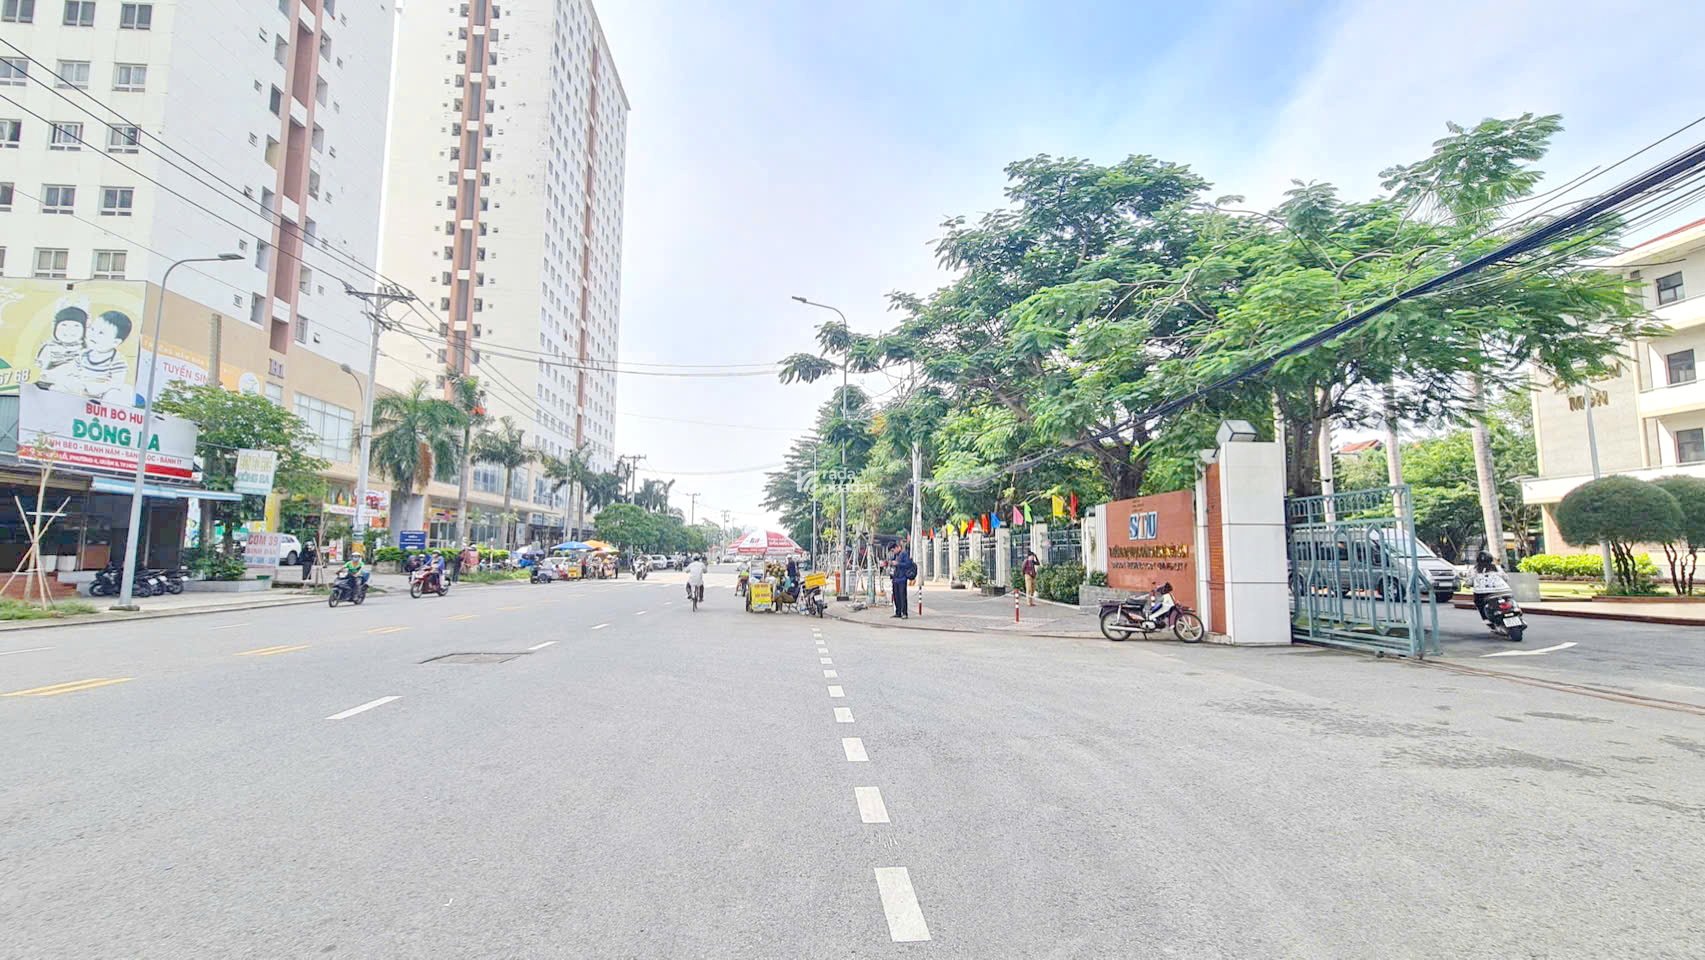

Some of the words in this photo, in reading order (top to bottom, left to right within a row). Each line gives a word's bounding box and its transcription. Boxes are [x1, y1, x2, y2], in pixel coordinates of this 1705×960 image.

[195, 370, 209, 385] SIN
[72, 417, 131, 447] ĐÔNG
[138, 431, 160, 451] A
[1129, 511, 1158, 540] STU
